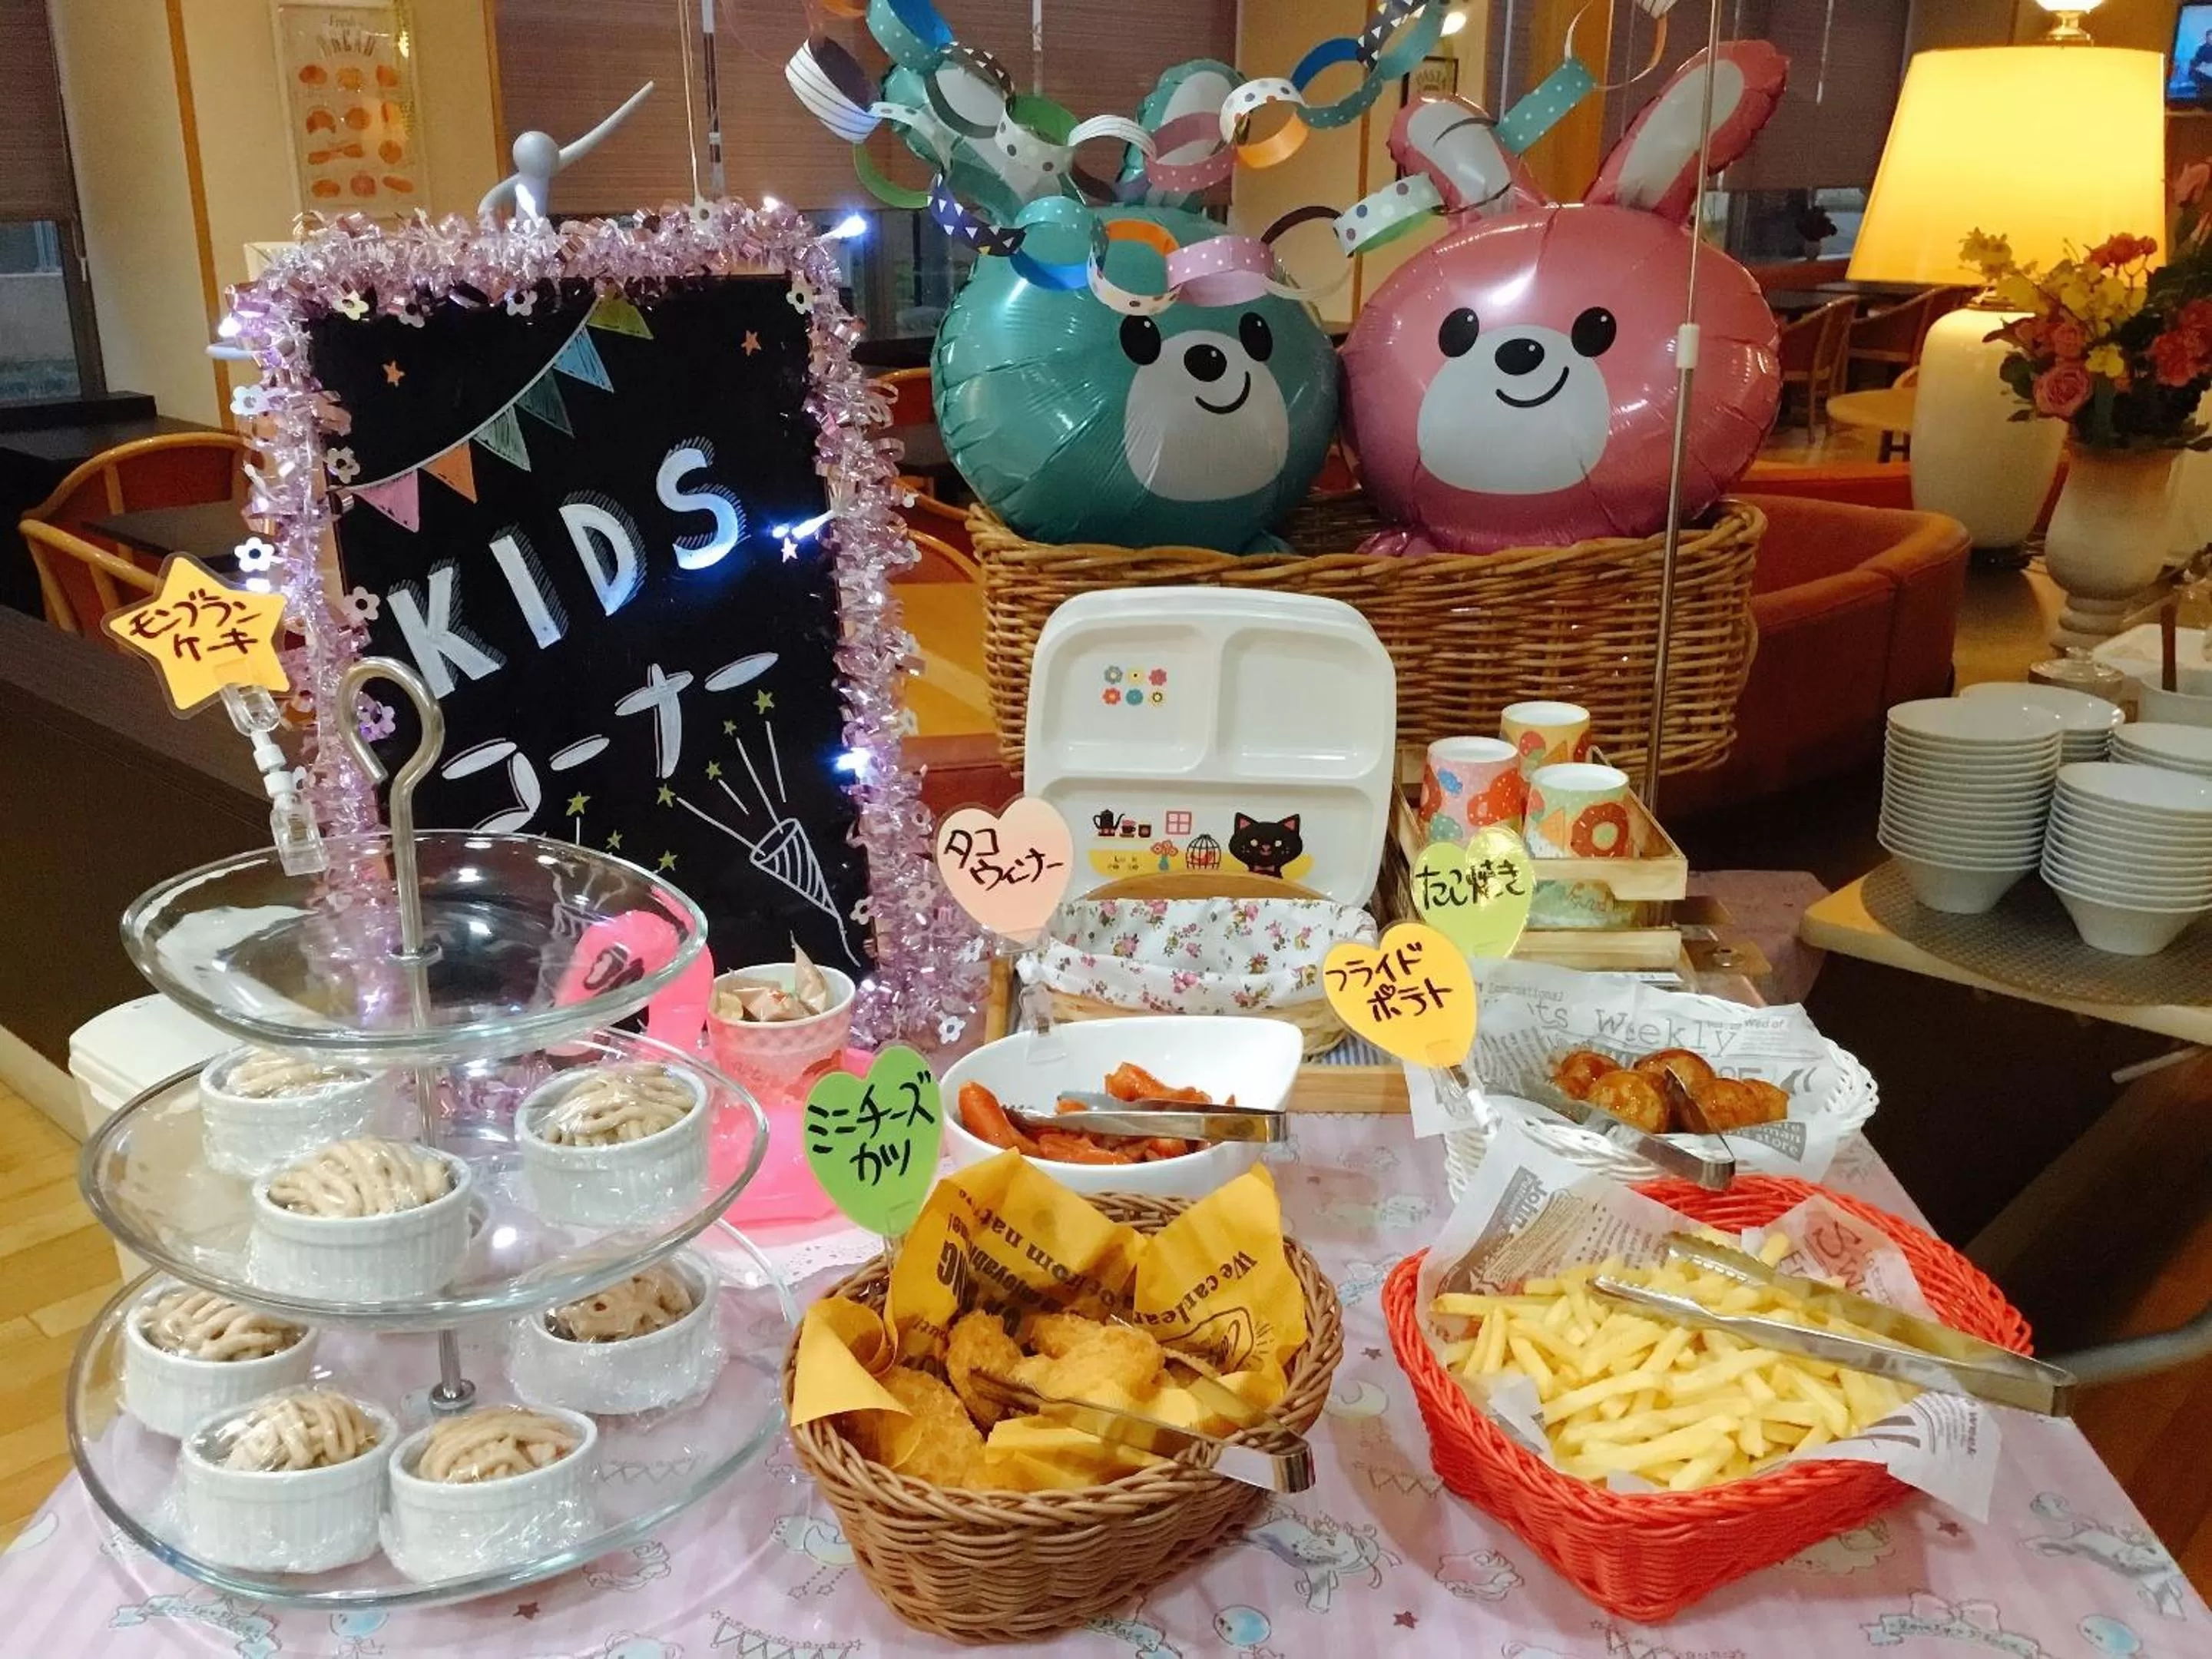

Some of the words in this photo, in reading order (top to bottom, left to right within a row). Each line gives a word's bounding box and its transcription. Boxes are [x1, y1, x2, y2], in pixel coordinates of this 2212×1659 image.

[386, 435, 750, 700] KIDS
[129, 588, 262, 638] モンブラン
[174, 628, 258, 661] ケーキ
[442, 652, 779, 834] コーナー
[943, 828, 1000, 869] タコ
[1416, 859, 1525, 910] たこ焼き
[1326, 942, 1422, 992] フライド
[1367, 978, 1453, 1022] ポテト
[807, 1070, 935, 1154] ミニチーズ
[849, 1138, 911, 1187] カツ
[1220, 1250, 1258, 1280] We
[1134, 1303, 1190, 1326] lear
